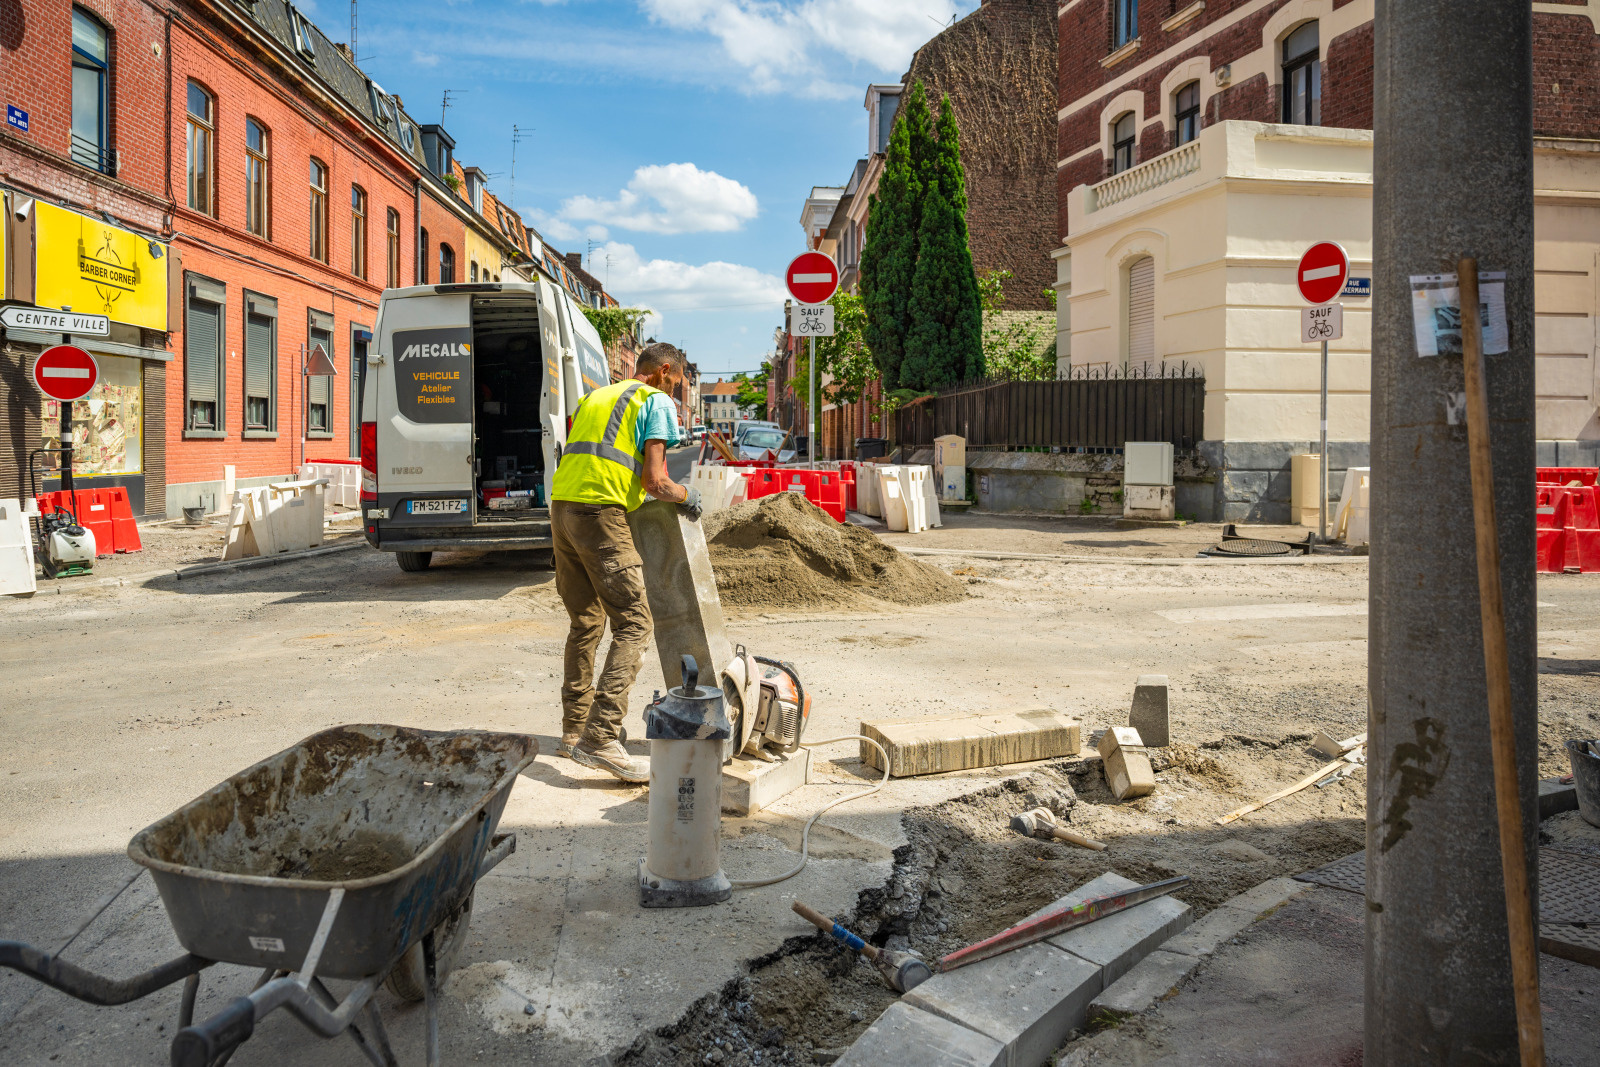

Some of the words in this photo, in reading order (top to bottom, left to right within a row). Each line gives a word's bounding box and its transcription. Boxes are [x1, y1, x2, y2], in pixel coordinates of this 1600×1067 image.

[80, 261, 108, 279] BARBER
[109, 270, 137, 286] CORNER
[1310, 308, 1332, 318] SAUF
[16, 313, 66, 327] CENTRE
[73, 318, 105, 330] VILLE
[412, 371, 460, 381] VEHICULE
[421, 384, 452, 393] Atelier
[417, 395, 456, 404] Flexibles
[391, 466, 423, 475] IVECO
[413, 500, 461, 511] FM-521-FZ
